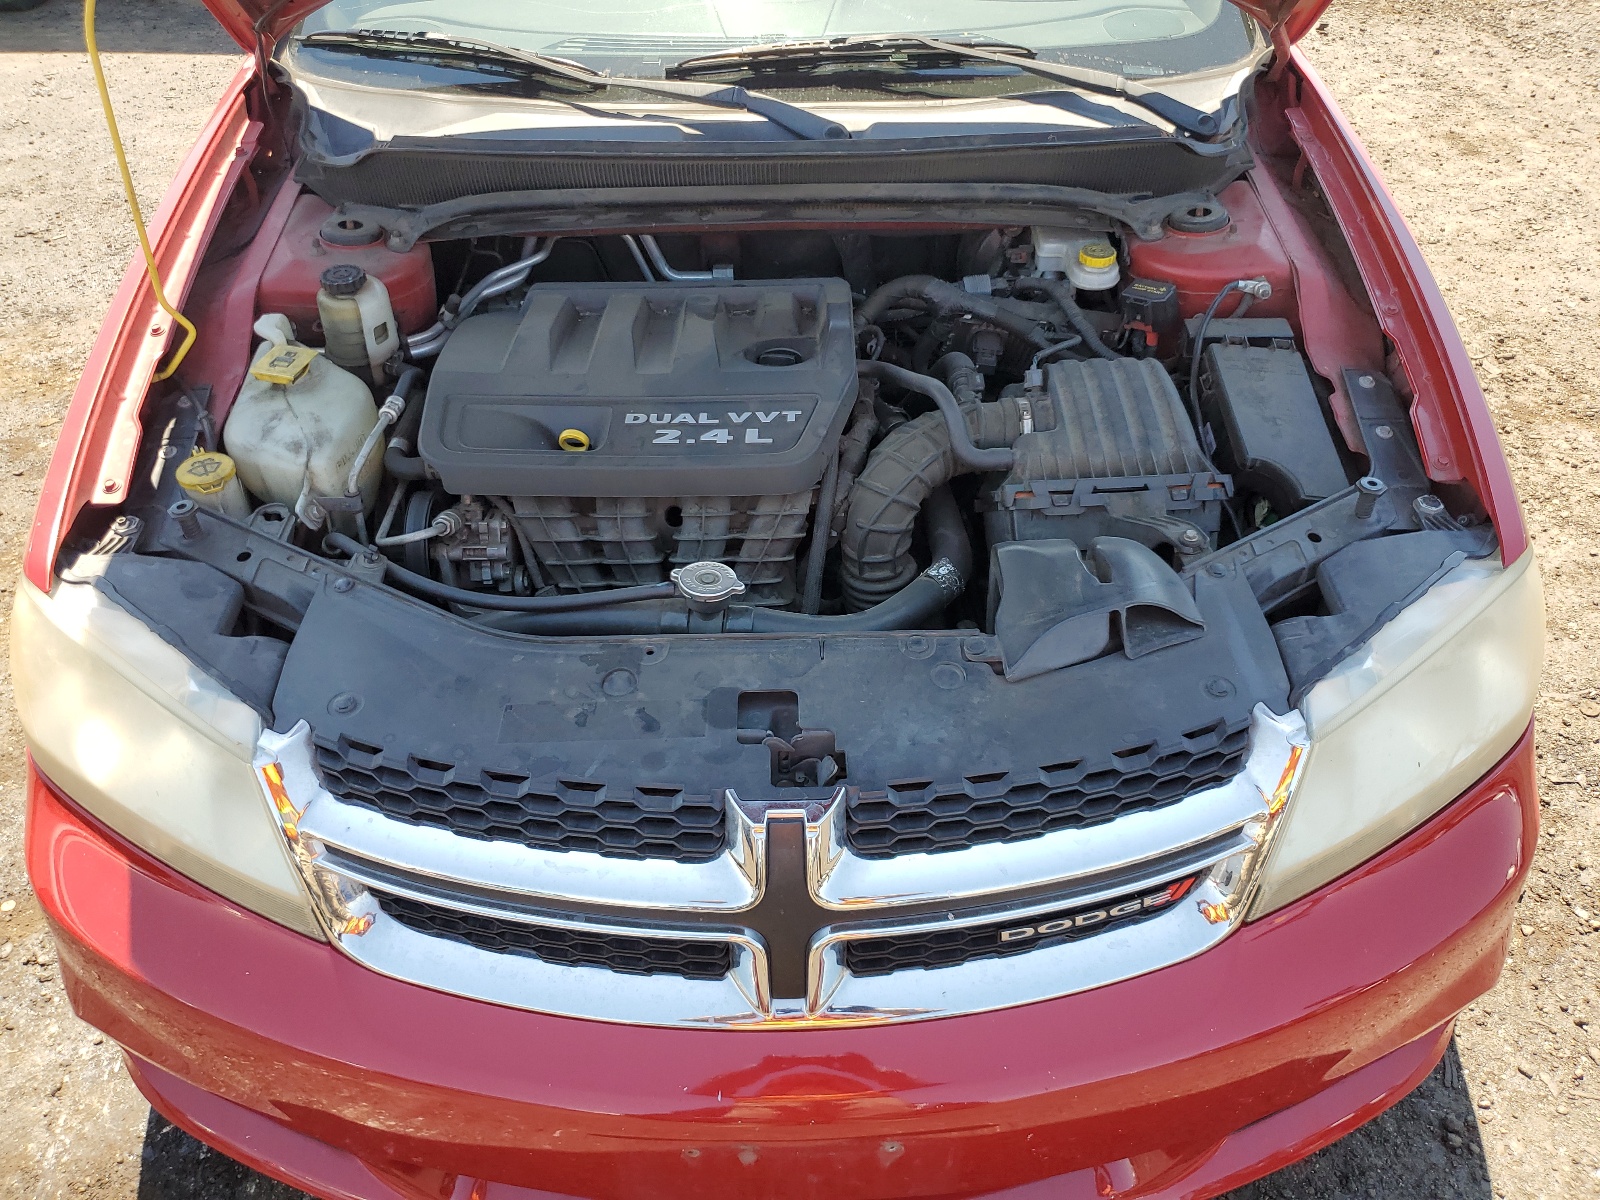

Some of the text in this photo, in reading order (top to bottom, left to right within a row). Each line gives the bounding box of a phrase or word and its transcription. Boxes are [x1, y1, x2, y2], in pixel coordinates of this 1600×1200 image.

[624, 410, 802, 424] DUAL VVT
[1000, 888, 1173, 943] DODGE
